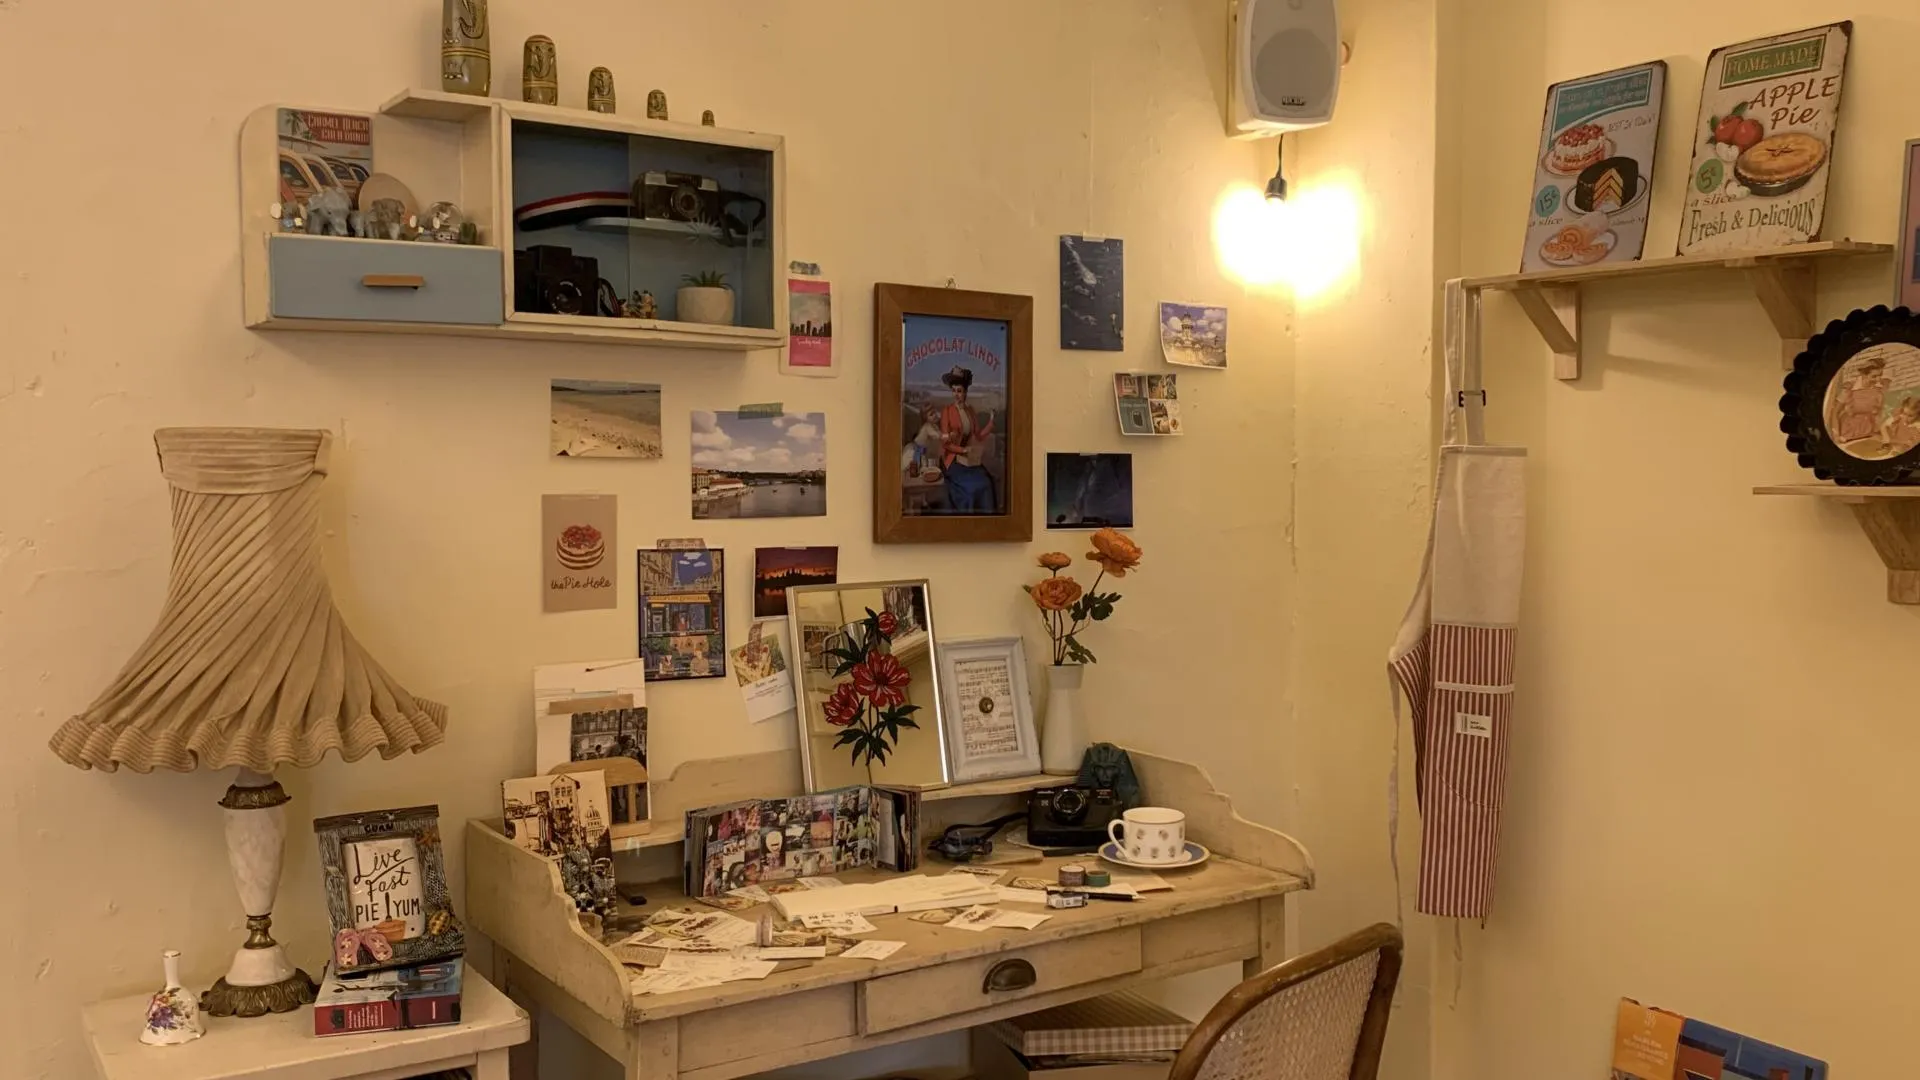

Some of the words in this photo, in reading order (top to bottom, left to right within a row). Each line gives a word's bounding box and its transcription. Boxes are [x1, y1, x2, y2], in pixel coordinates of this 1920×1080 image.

[1726, 55, 1770, 77] HOME
[1773, 44, 1820, 67] MADE
[1747, 75, 1839, 110] APPLE
[1770, 105, 1820, 130] Pie
[1687, 209, 1728, 247] Fresh
[1731, 210, 1744, 231] &
[1748, 198, 1815, 236] Delicious
[905, 336, 966, 369] CHOCOLAT
[968, 340, 1001, 371] LINDT
[353, 844, 402, 885] Live
[365, 856, 414, 902] Fast
[355, 902, 380, 924] PIE
[393, 897, 420, 917] YUM
